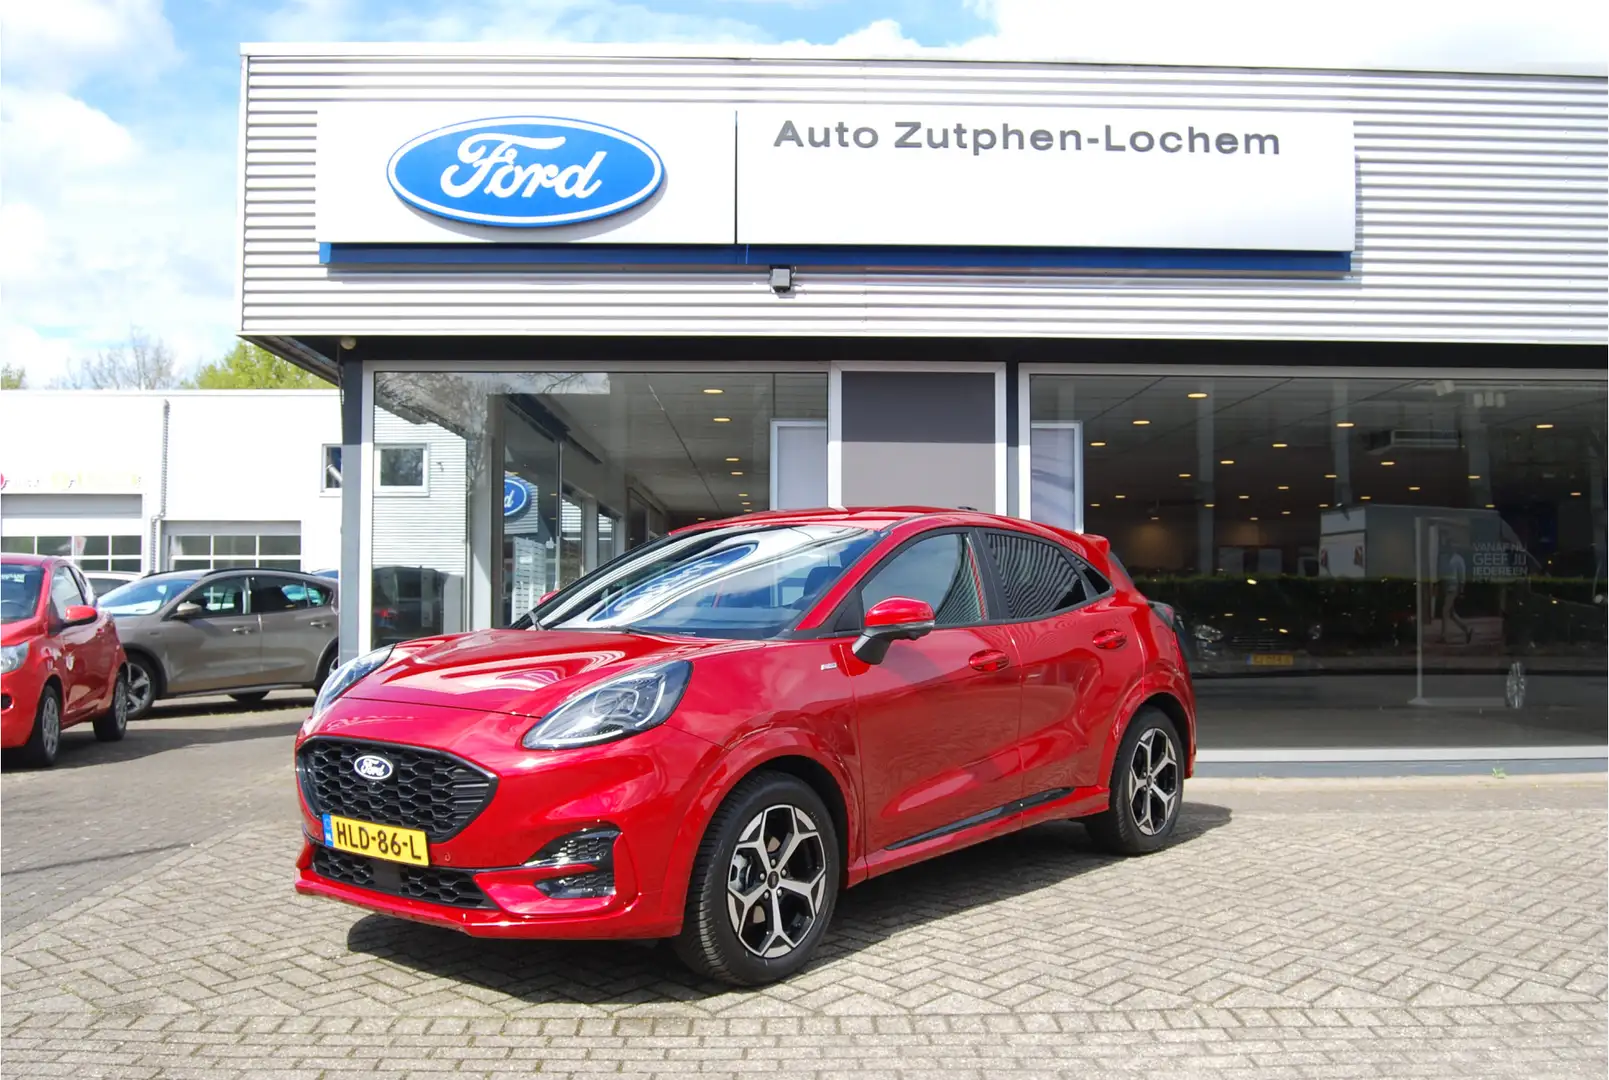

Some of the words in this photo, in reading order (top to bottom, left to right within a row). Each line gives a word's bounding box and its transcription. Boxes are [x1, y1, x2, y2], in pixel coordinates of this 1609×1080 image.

[773, 120, 879, 148] Auto
[894, 121, 1280, 156] Zutphen-Lochem
[440, 133, 608, 198] Ford
[1473, 553, 1509, 566] GEEF
[361, 758, 385, 776] Ford
[336, 822, 421, 860] HLD-86-L
